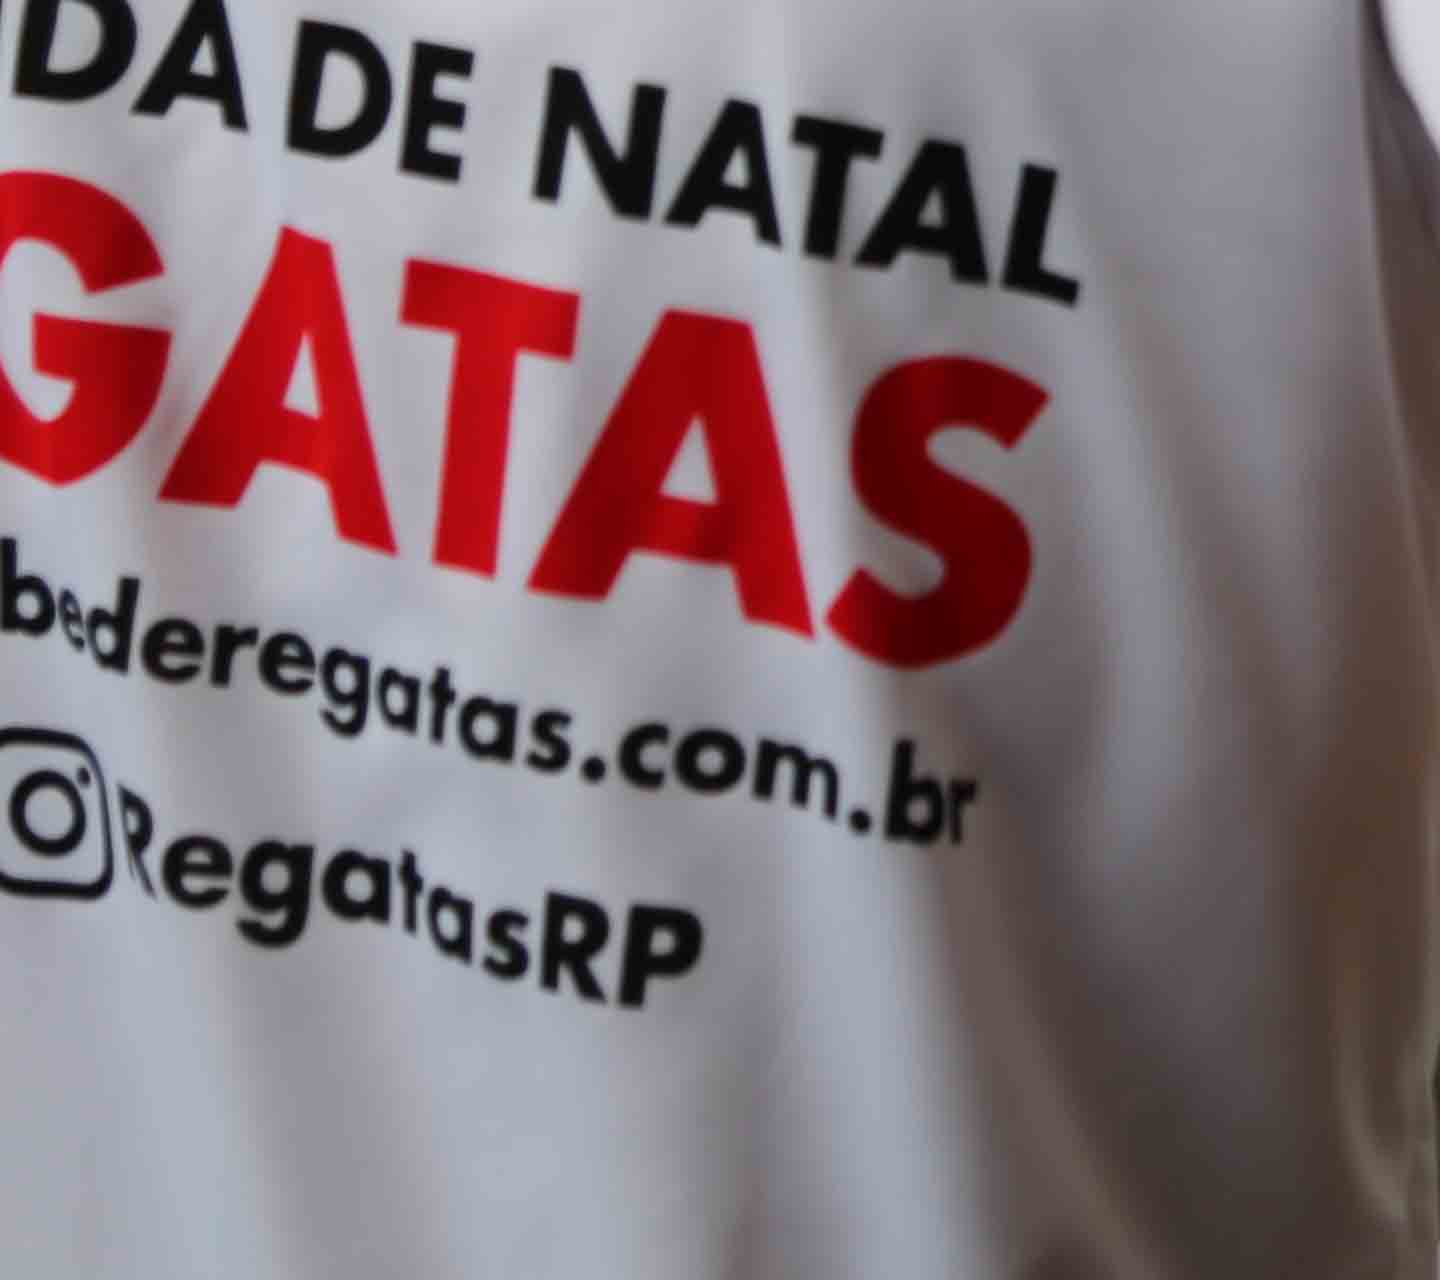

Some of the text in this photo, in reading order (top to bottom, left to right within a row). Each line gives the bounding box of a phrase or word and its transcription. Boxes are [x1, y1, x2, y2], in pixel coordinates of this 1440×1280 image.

[285, 19, 475, 184] DE
[532, 67, 1081, 309] NATAL
[118, 780, 704, 1010] RegatasRP
